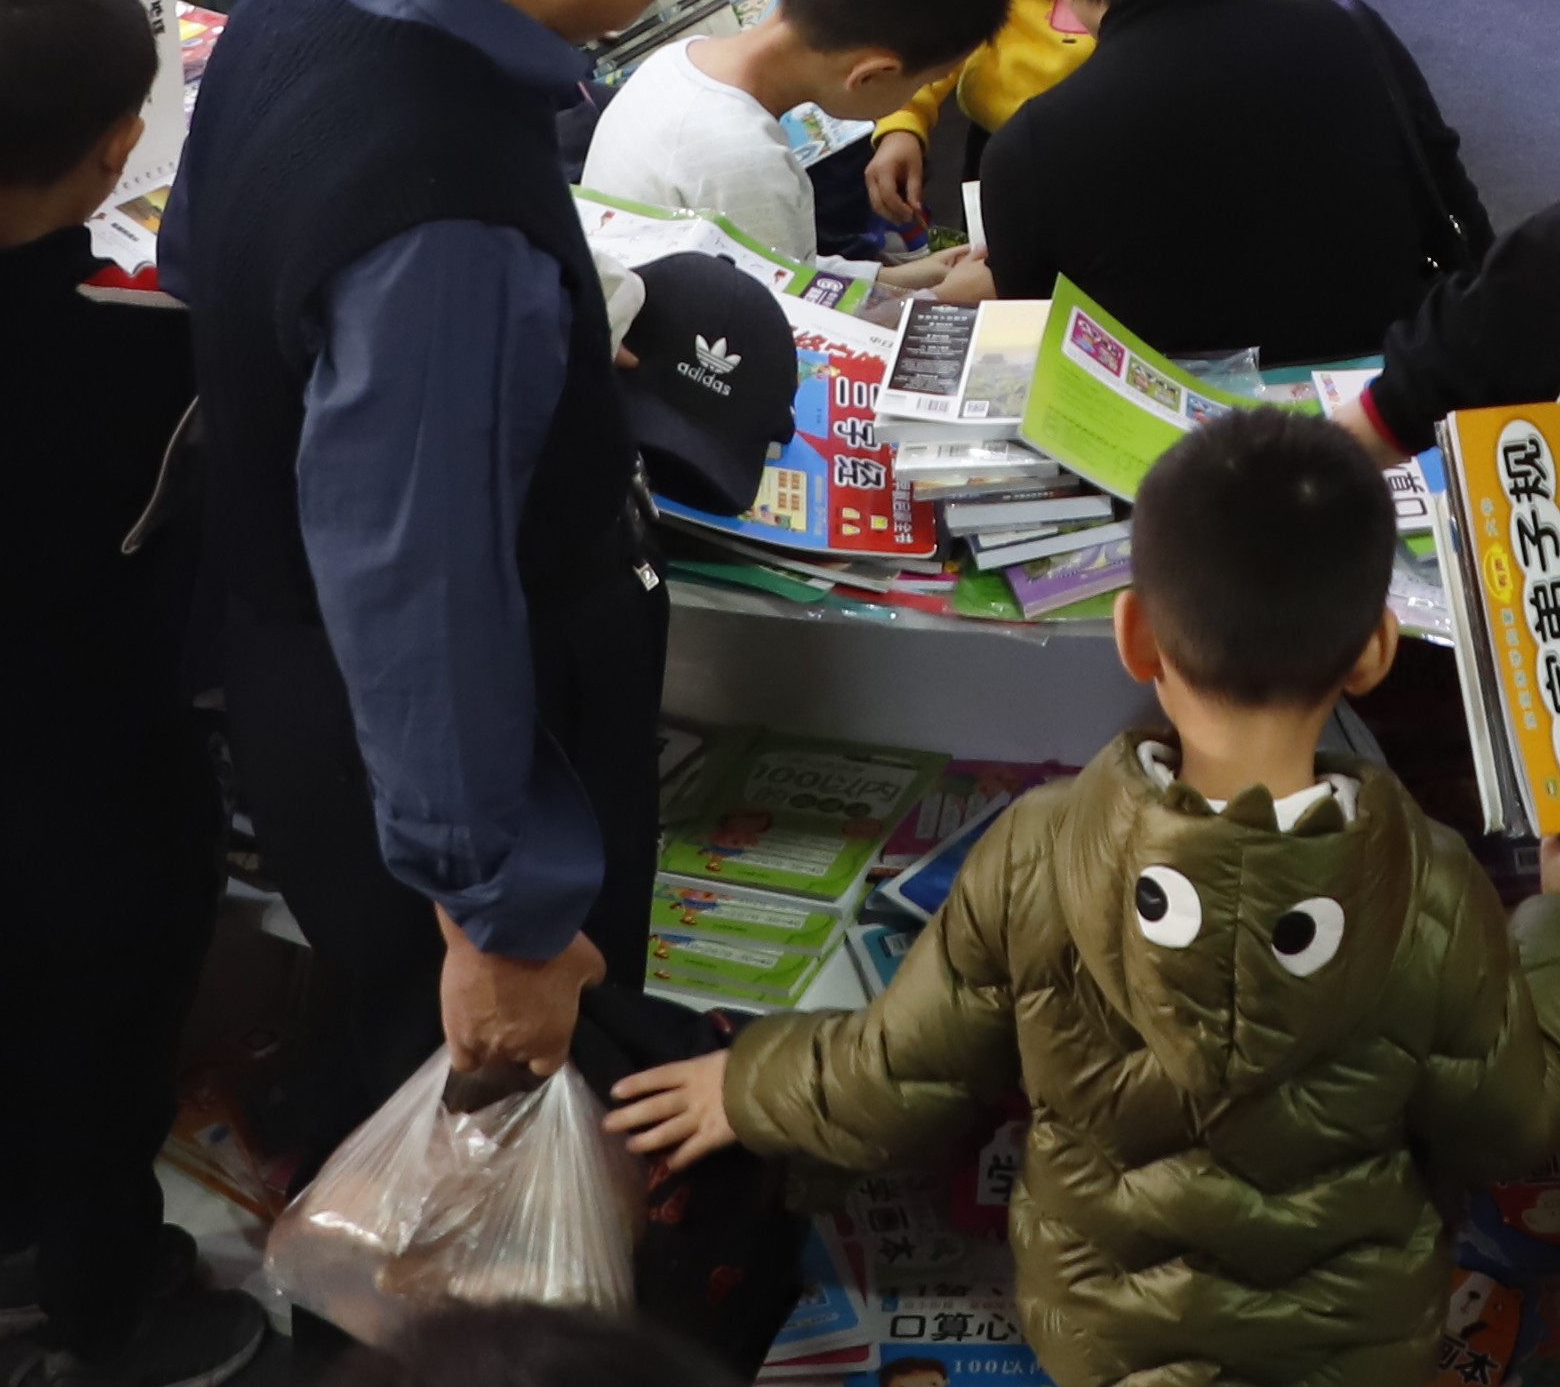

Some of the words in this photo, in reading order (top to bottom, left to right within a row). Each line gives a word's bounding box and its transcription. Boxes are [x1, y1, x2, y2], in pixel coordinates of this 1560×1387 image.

[676, 361, 733, 397] adidas
[832, 375, 889, 491] 三字经
[890, 1310, 1023, 1343] 口算心
